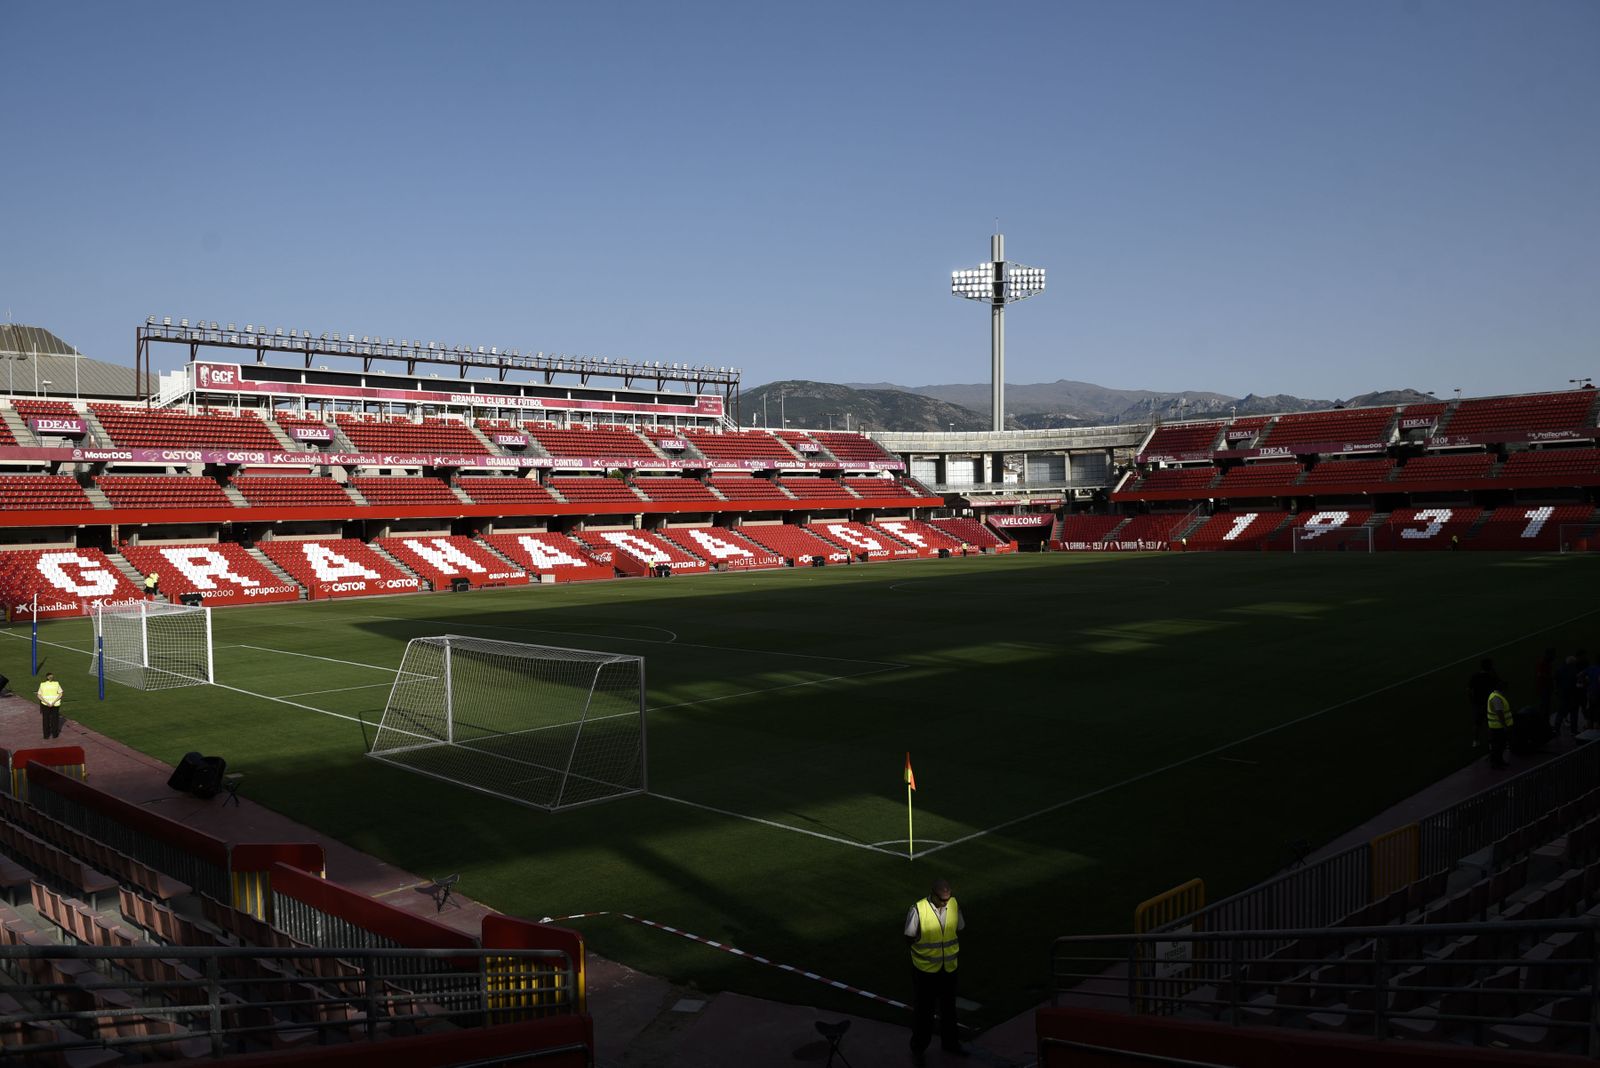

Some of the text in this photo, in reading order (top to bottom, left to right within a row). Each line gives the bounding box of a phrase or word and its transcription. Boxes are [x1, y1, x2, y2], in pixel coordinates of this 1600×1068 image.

[211, 370, 235, 382] GCF
[450, 395, 485, 404] GRANADA
[486, 396, 506, 405] CLUB
[37, 420, 81, 430] IDEAL
[1402, 417, 1431, 428] IDEAL
[295, 428, 330, 438] IDEAL
[1229, 431, 1252, 439] IDEAL
[498, 435, 526, 444] IDEAL
[662, 440, 685, 448] IDEAL
[84, 451, 133, 459] MotorDOS
[162, 451, 202, 460] CASTOR
[1259, 446, 1291, 455] IDEAL
[227, 452, 265, 462] CASTOR
[283, 454, 323, 464] CaixaBank
[340, 455, 377, 464] CaixaBank
[393, 456, 428, 465] CaixaBank
[442, 457, 476, 466] CaixaBank
[486, 457, 583, 467] GRANADA SIEMPRE CONTIGO
[600, 459, 628, 467] CaixaBank
[639, 460, 667, 468] CaixaBank
[774, 460, 796, 468] Granada
[1001, 517, 1042, 525] WELCOME
[734, 556, 778, 566] HOTEL LUNA
[332, 582, 366, 592] CASTOR
[386, 578, 419, 588] CASTOR
[250, 585, 295, 597] grupo2000
[29, 601, 79, 612] CaixaBank
[104, 597, 149, 608] CaixaBank
